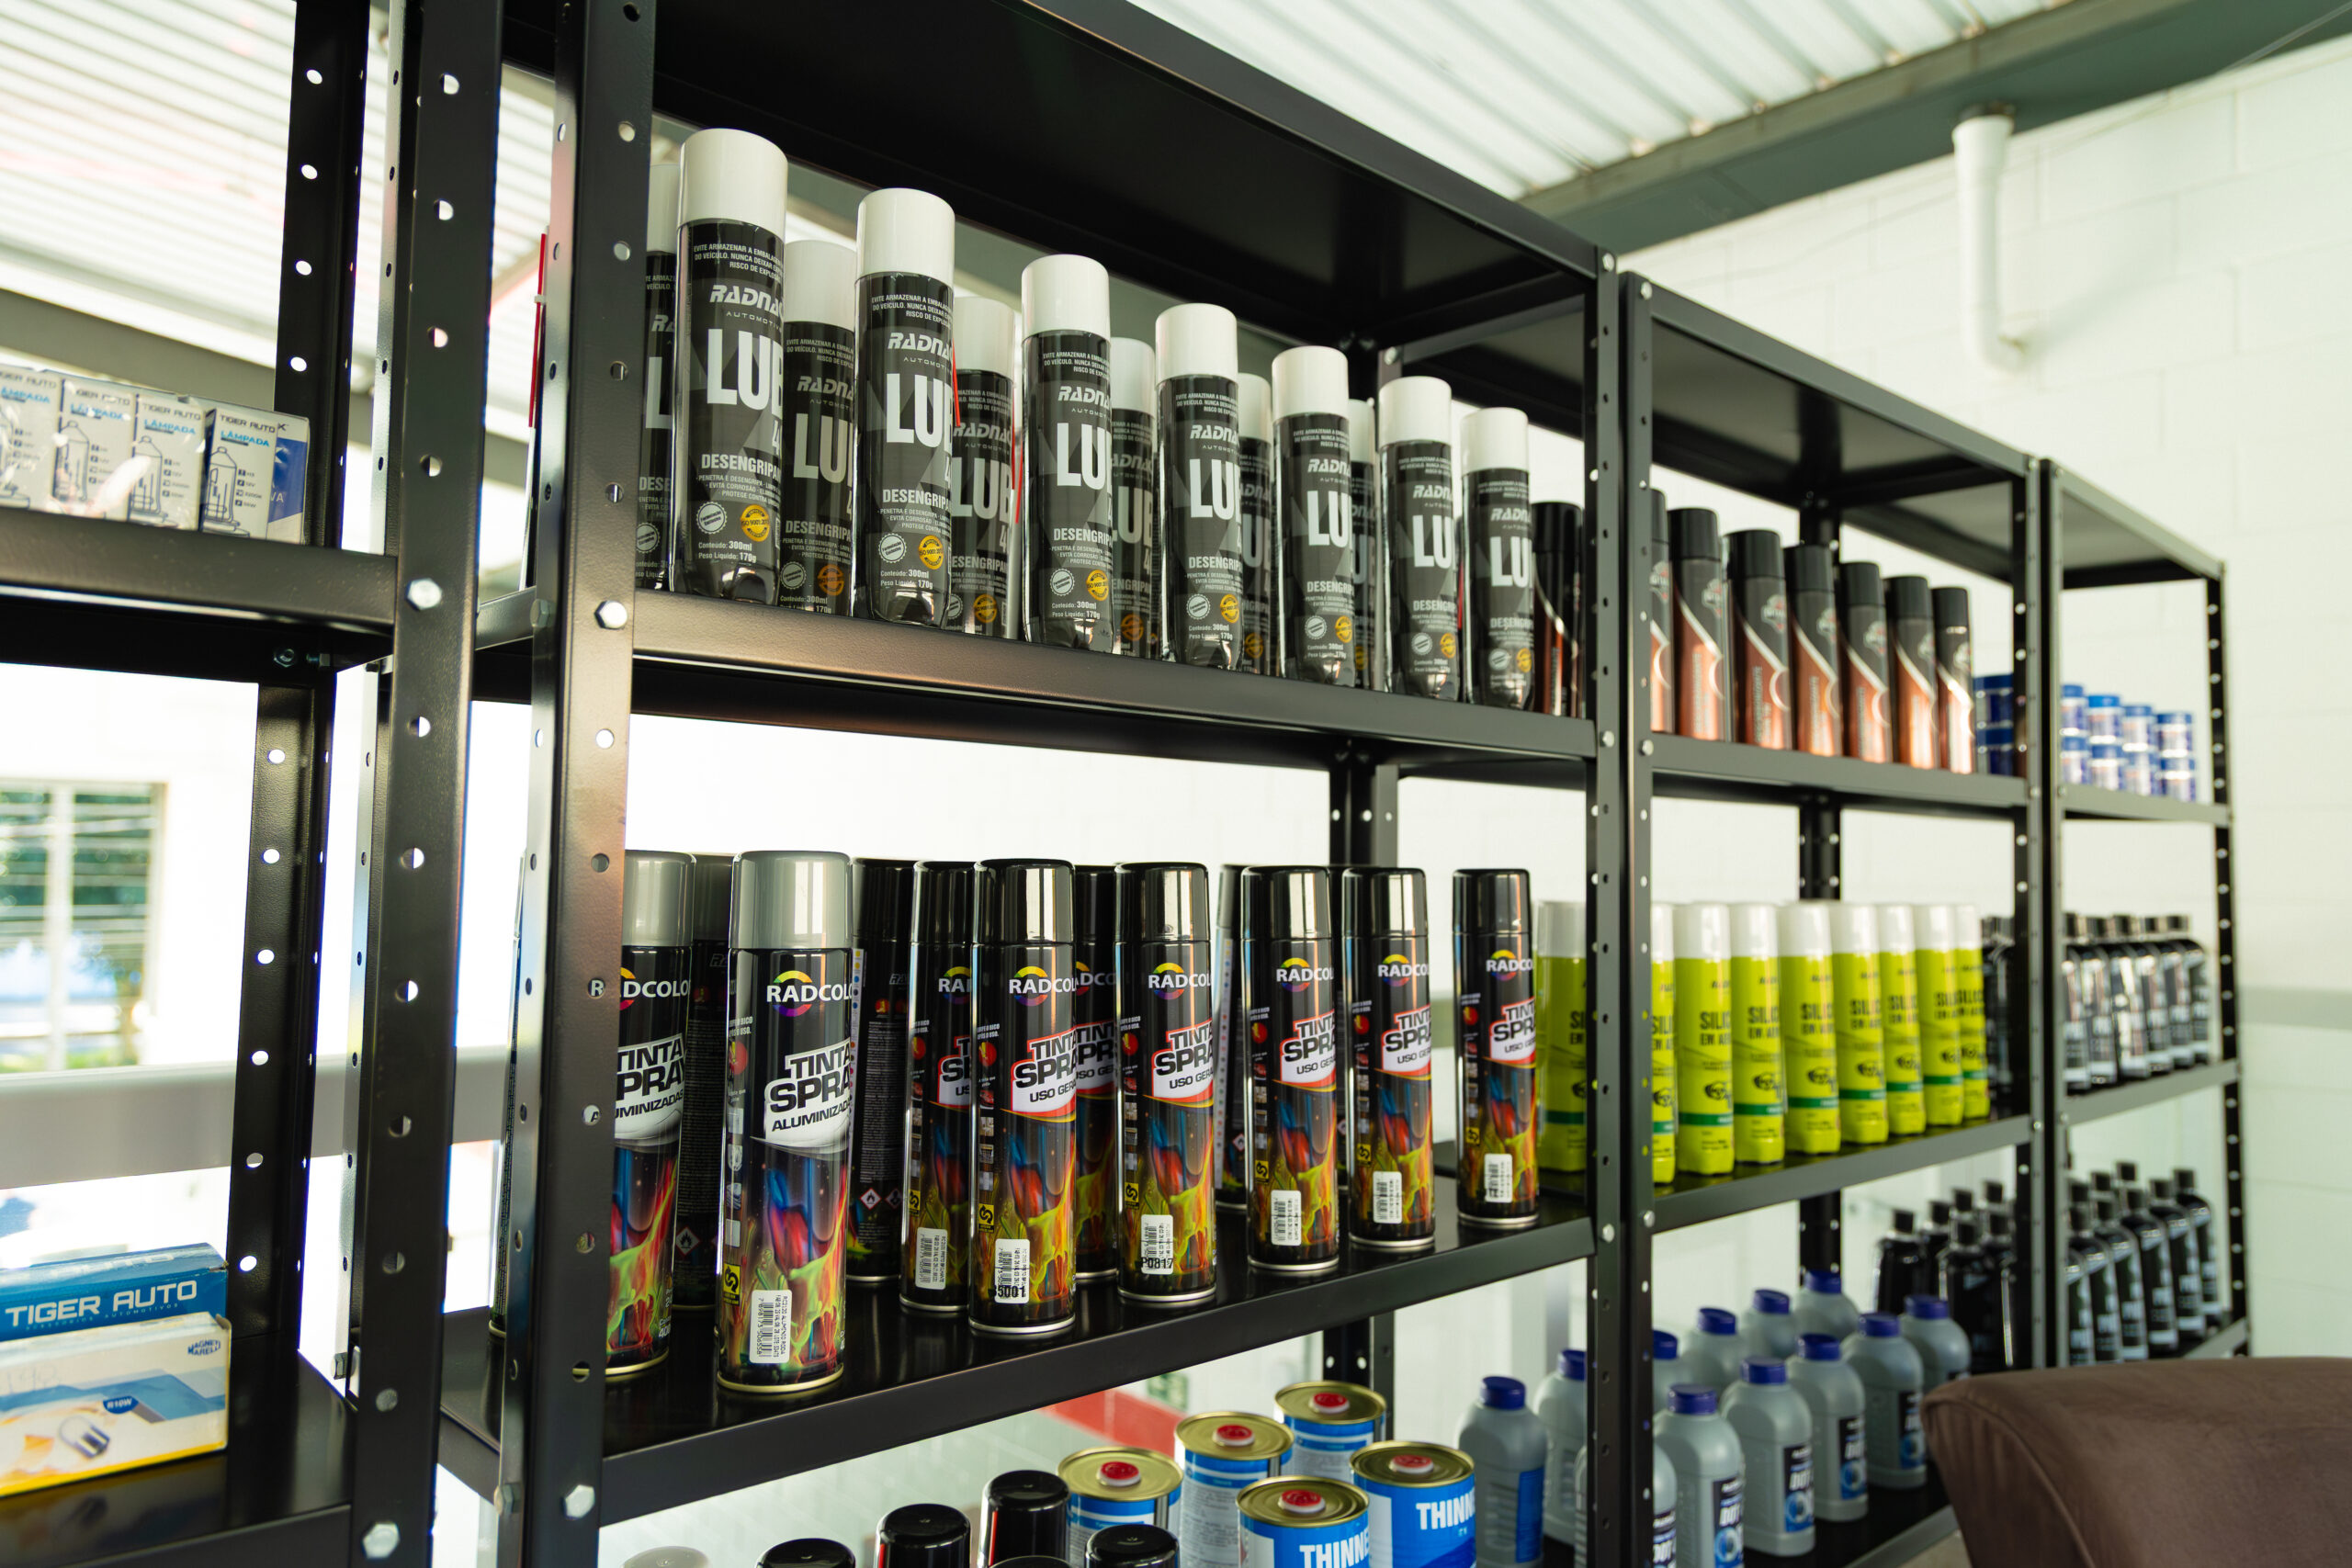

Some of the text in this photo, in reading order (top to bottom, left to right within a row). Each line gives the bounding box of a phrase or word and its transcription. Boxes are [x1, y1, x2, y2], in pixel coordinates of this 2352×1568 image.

[694, 244, 707, 253] EVITE
[709, 243, 746, 253] ARMAZENAR
[704, 251, 729, 261] VEÍCULO.
[731, 254, 752, 263] NUNCA
[753, 257, 773, 268] DEIXAR
[729, 261, 750, 270] RISCO
[871, 294, 922, 303] EVITE ARMAZENAR
[880, 301, 906, 310] VEÍCULO.
[907, 303, 927, 311] NUNCA
[726, 310, 782, 331] AUTOMOTIV
[906, 310, 933, 321] RISCO DE
[1057, 351, 1086, 359] ARMAZENAR
[1, 387, 50, 402] ÂMPADA
[797, 375, 854, 400] RADNA
[102, 394, 130, 406] ATO
[1058, 386, 1111, 412] RADNA
[143, 403, 202, 421] TIGER AUTO
[220, 413, 247, 428] TIGER
[250, 421, 276, 434] AUTO
[220, 430, 270, 446] LÂMPADA
[1190, 424, 1240, 446] RADNA
[1307, 458, 1351, 478] RADNA
[722, 491, 747, 499] PROTEGE
[1413, 485, 1452, 502] RADN
[786, 520, 852, 542] DESENGRIPA
[1053, 527, 1112, 547] DESENGRIP
[729, 540, 752, 551] 300ml
[740, 552, 757, 564] 170g
[952, 556, 1007, 573] ESENGRIPA
[1189, 557, 1242, 573] DESENGRIP
[908, 570, 930, 579] 300ml
[917, 580, 933, 590] 170g
[807, 595, 828, 604] 300ml
[1077, 601, 1097, 610] 300ml
[1086, 610, 1101, 619] 170g
[1213, 624, 1229, 632] 300ml
[1220, 632, 1233, 641] 170g
[1378, 964, 1430, 977] RADCO
[1487, 959, 1534, 973] RADCO
[1148, 973, 1212, 988] RADCOL
[1276, 967, 1334, 983] RADCOL
[1009, 977, 1077, 995] RADCOL
[1505, 999, 1536, 1021] TINT
[1398, 1011, 1431, 1031] TINT
[1385, 1022, 1431, 1053] SPR
[1494, 1017, 1536, 1043] SPR
[1284, 1030, 1335, 1063] SPR
[1156, 1042, 1213, 1077] SPRA
[1397, 1053, 1417, 1065] USO
[1015, 1049, 1077, 1089] SPRA
[1296, 1062, 1318, 1075] USO
[616, 1058, 684, 1101] PRA
[1169, 1076, 1193, 1089] USO
[770, 1066, 851, 1113] SPRA
[1029, 1088, 1055, 1103] USO
[772, 1099, 851, 1132] ALUMINIZAD
[6, 1280, 197, 1327] TIGER AUTO
[105, 1303, 178, 1319] AUTOMOTIVOS
[1416, 1486, 1476, 1530] THINN
[1299, 1527, 1370, 1568] THINNE
